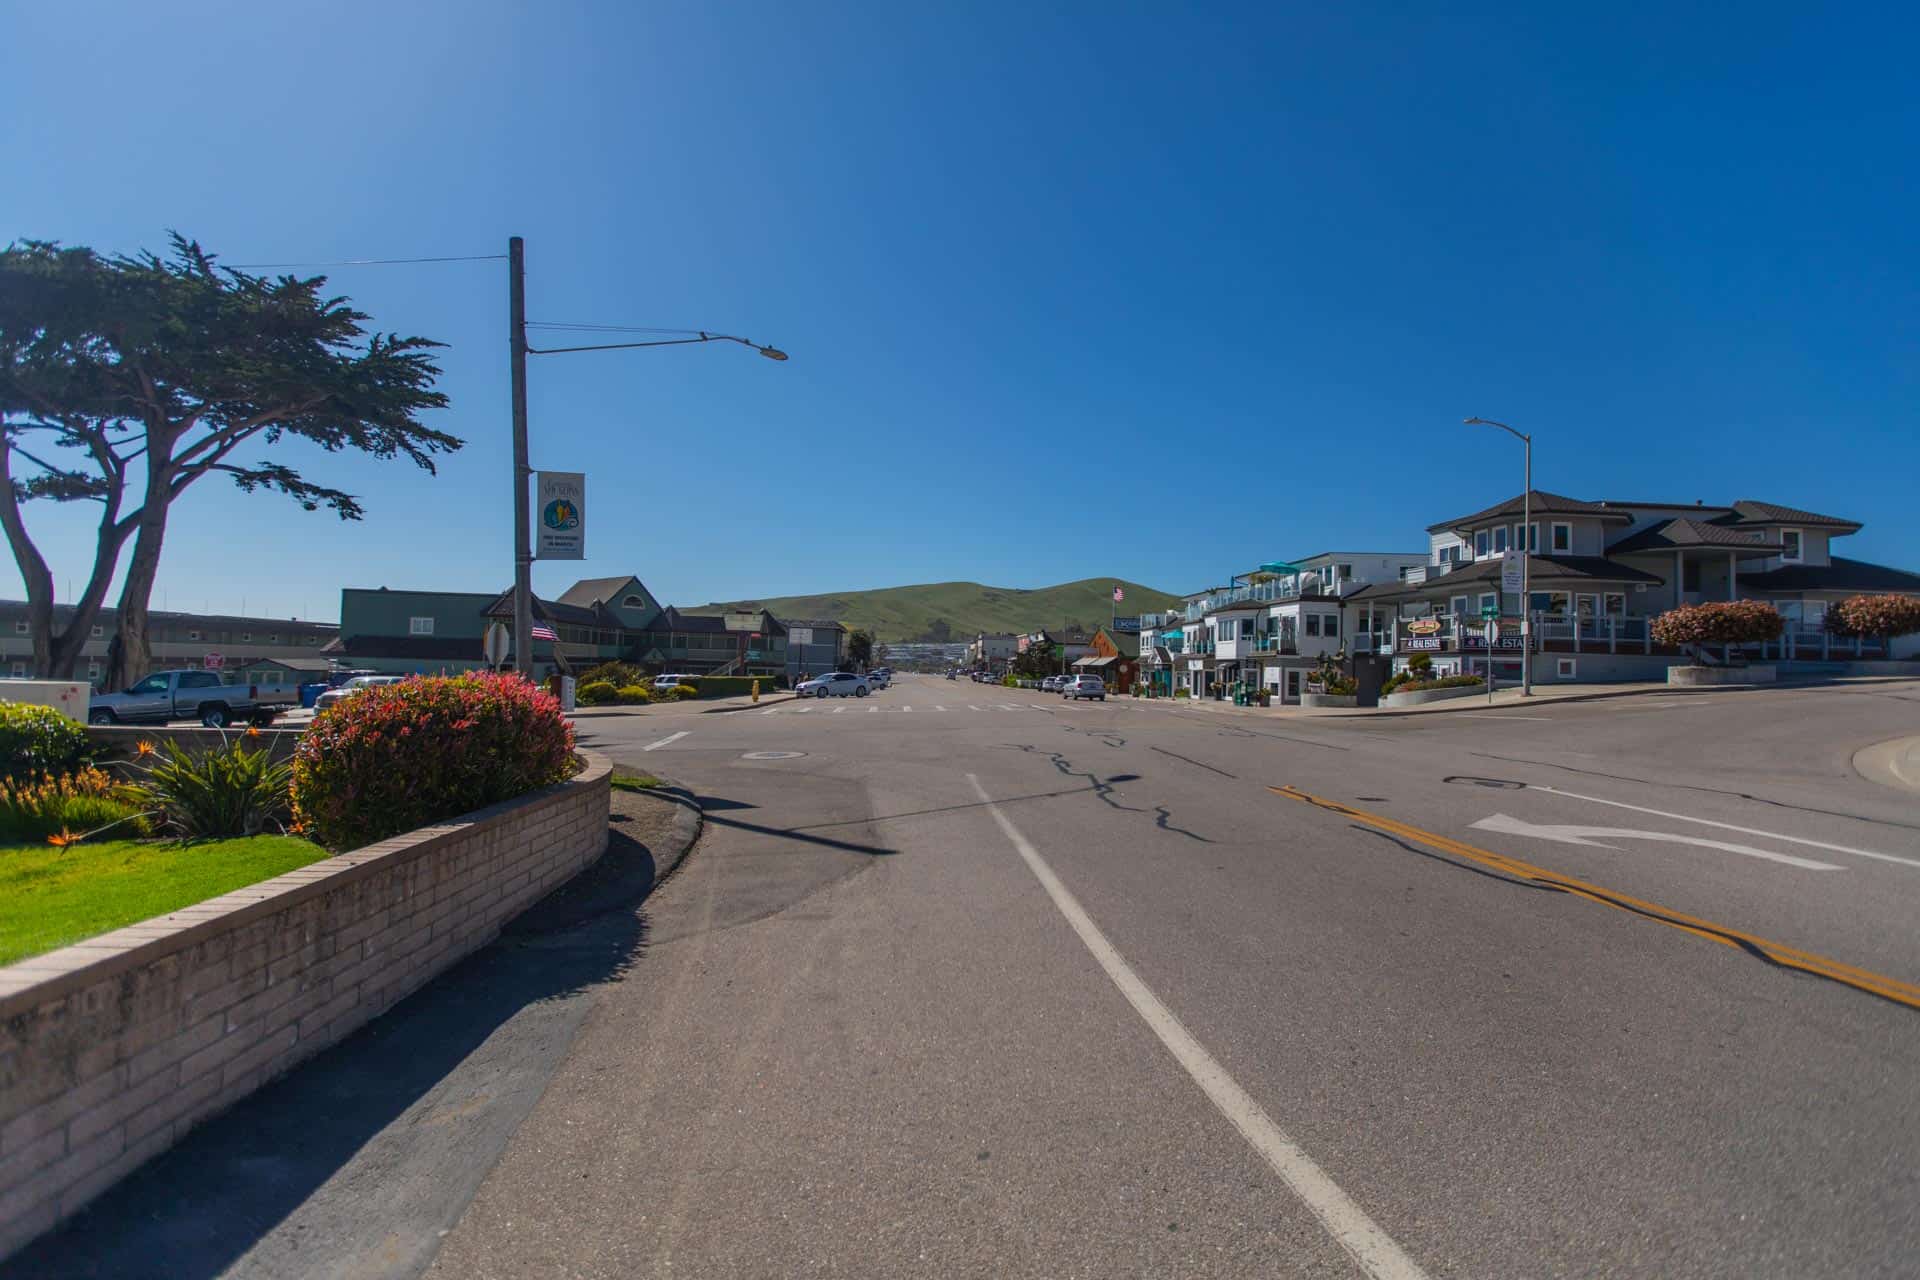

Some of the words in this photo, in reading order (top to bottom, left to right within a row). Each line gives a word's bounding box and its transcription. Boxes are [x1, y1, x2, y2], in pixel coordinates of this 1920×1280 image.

[1412, 639, 1424, 648] REAL
[1424, 639, 1440, 648] ESTATE
[1503, 639, 1534, 648] ESTAE
